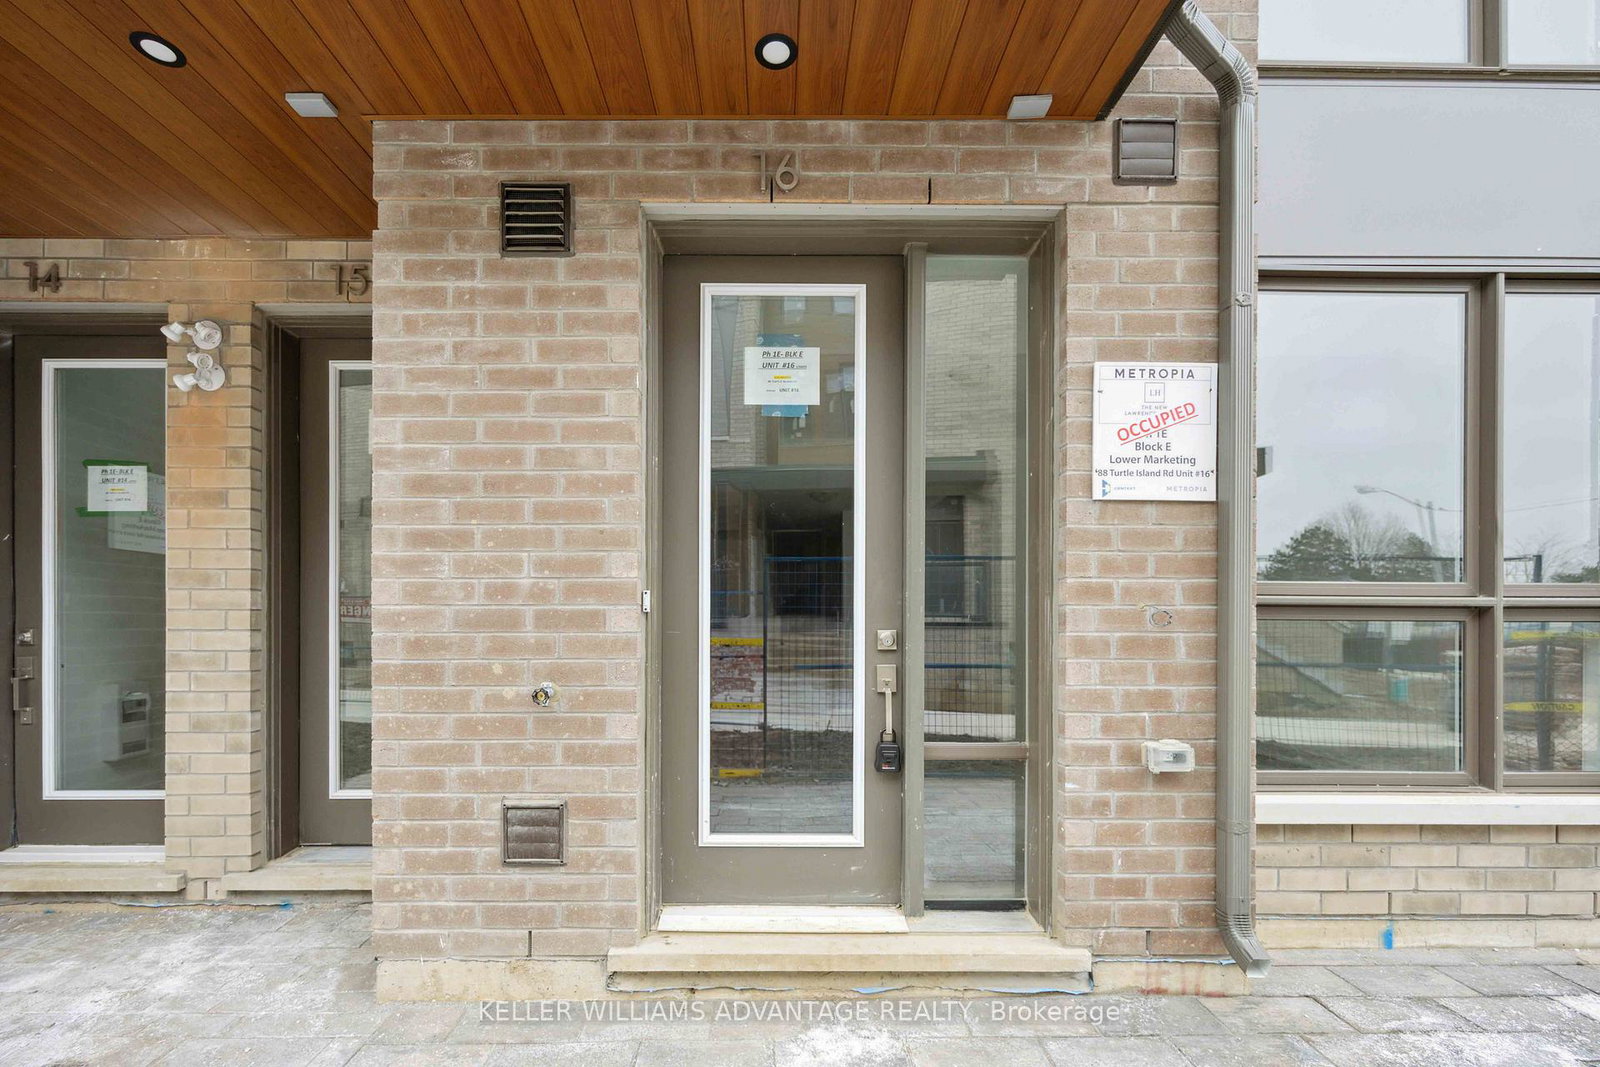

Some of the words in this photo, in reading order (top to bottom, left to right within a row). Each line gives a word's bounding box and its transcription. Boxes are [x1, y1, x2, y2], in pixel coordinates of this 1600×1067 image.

[752, 147, 799, 192] 16
[24, 261, 62, 293] 14
[330, 263, 371, 296] 15
[1114, 368, 1196, 379] METROPIA
[1117, 402, 1197, 441] OCCUPIED
[1135, 442, 1163, 451] Block
[1165, 442, 1172, 451] E
[1109, 455, 1141, 464] Lower
[1143, 455, 1197, 467] Marketing
[1110, 469, 1134, 477] Turtle
[1136, 469, 1161, 477] Island
[1162, 469, 1174, 477] Rd
[1175, 469, 1193, 477] Unit
